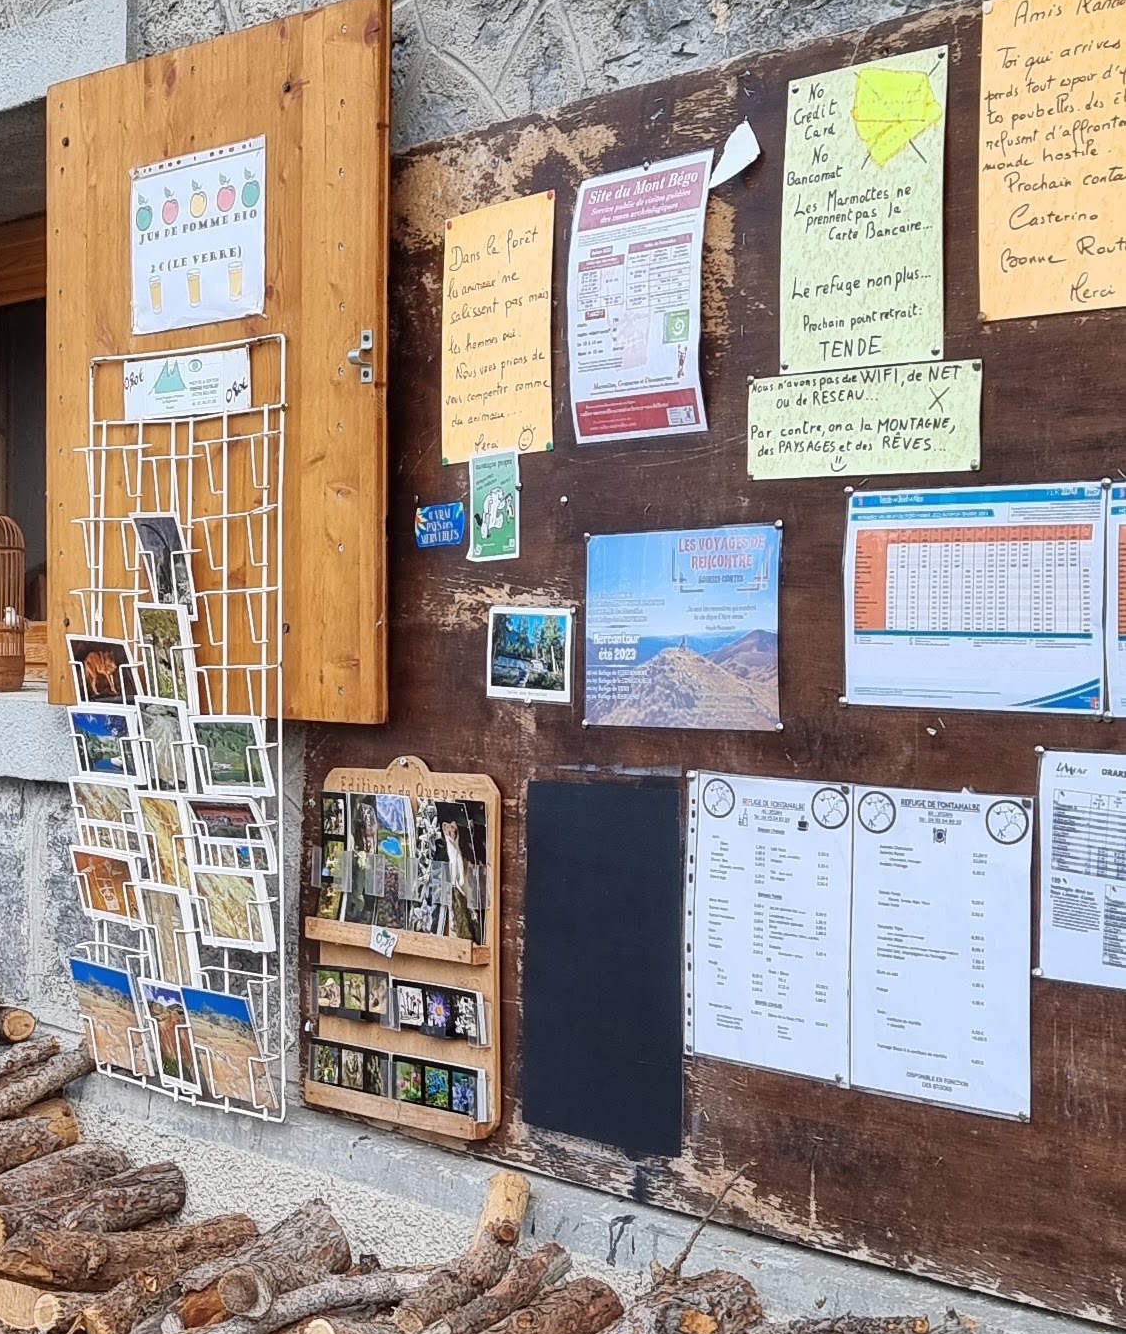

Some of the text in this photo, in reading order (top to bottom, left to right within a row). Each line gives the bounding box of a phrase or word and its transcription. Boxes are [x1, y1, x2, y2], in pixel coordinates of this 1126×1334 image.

[1014, 0, 1062, 27] Amis
[997, 39, 1121, 81] Toi qui arrives
[808, 82, 824, 103] No
[984, 84, 1019, 113] perds
[1026, 75, 1056, 94] tout
[1060, 72, 1098, 92] espoir
[794, 99, 838, 125] Credit
[804, 123, 835, 140] Card
[986, 129, 1039, 158] refusent
[812, 144, 828, 166] No
[982, 154, 1034, 172] monde
[588, 171, 698, 205] Site du Mont Bégo
[787, 166, 843, 186] Bancomat
[1004, 171, 1072, 193] Prochain
[636, 198, 644, 207] de
[794, 186, 911, 217] Les Marmottes ne
[139, 209, 258, 245] JUS DE POMME BIO
[806, 202, 901, 233] prennent pas la
[1009, 203, 1099, 230] Casterino
[828, 226, 858, 240] Carte
[192, 245, 242, 265] VERRE)
[449, 227, 539, 271] Dans la forêt
[1000, 235, 1126, 273] Bonne Rout
[502, 271, 520, 284] ne
[792, 266, 931, 300] Le refuge non plus...
[1070, 272, 1116, 304] Merci
[450, 290, 549, 325] salissent pas mais
[803, 315, 844, 333] Prochain
[851, 311, 876, 330] point
[819, 335, 882, 362] TENDE
[455, 348, 545, 379] Nous vous prions de
[751, 380, 774, 394] Nous
[777, 379, 817, 390] n'avons
[819, 375, 840, 390] pas
[860, 368, 905, 387] WIFI,
[907, 369, 922, 382] de
[928, 365, 962, 382] NET
[446, 393, 462, 406] vous
[515, 380, 550, 392] comme
[776, 398, 790, 409] ou
[796, 394, 808, 406] de
[751, 417, 956, 440] Par contre, on a la MONTAGNE,
[474, 434, 499, 452] Merci
[758, 443, 774, 457] des
[778, 440, 836, 454] PAYSAGES
[839, 441, 852, 452] et
[855, 440, 873, 451] des
[678, 535, 765, 554] LES VOYAGES DE
[691, 553, 752, 569] RENCONTRE
[598, 647, 636, 660] été 2023
[340, 775, 475, 800] Editions du Queyras
[901, 798, 925, 808] REFUGE
